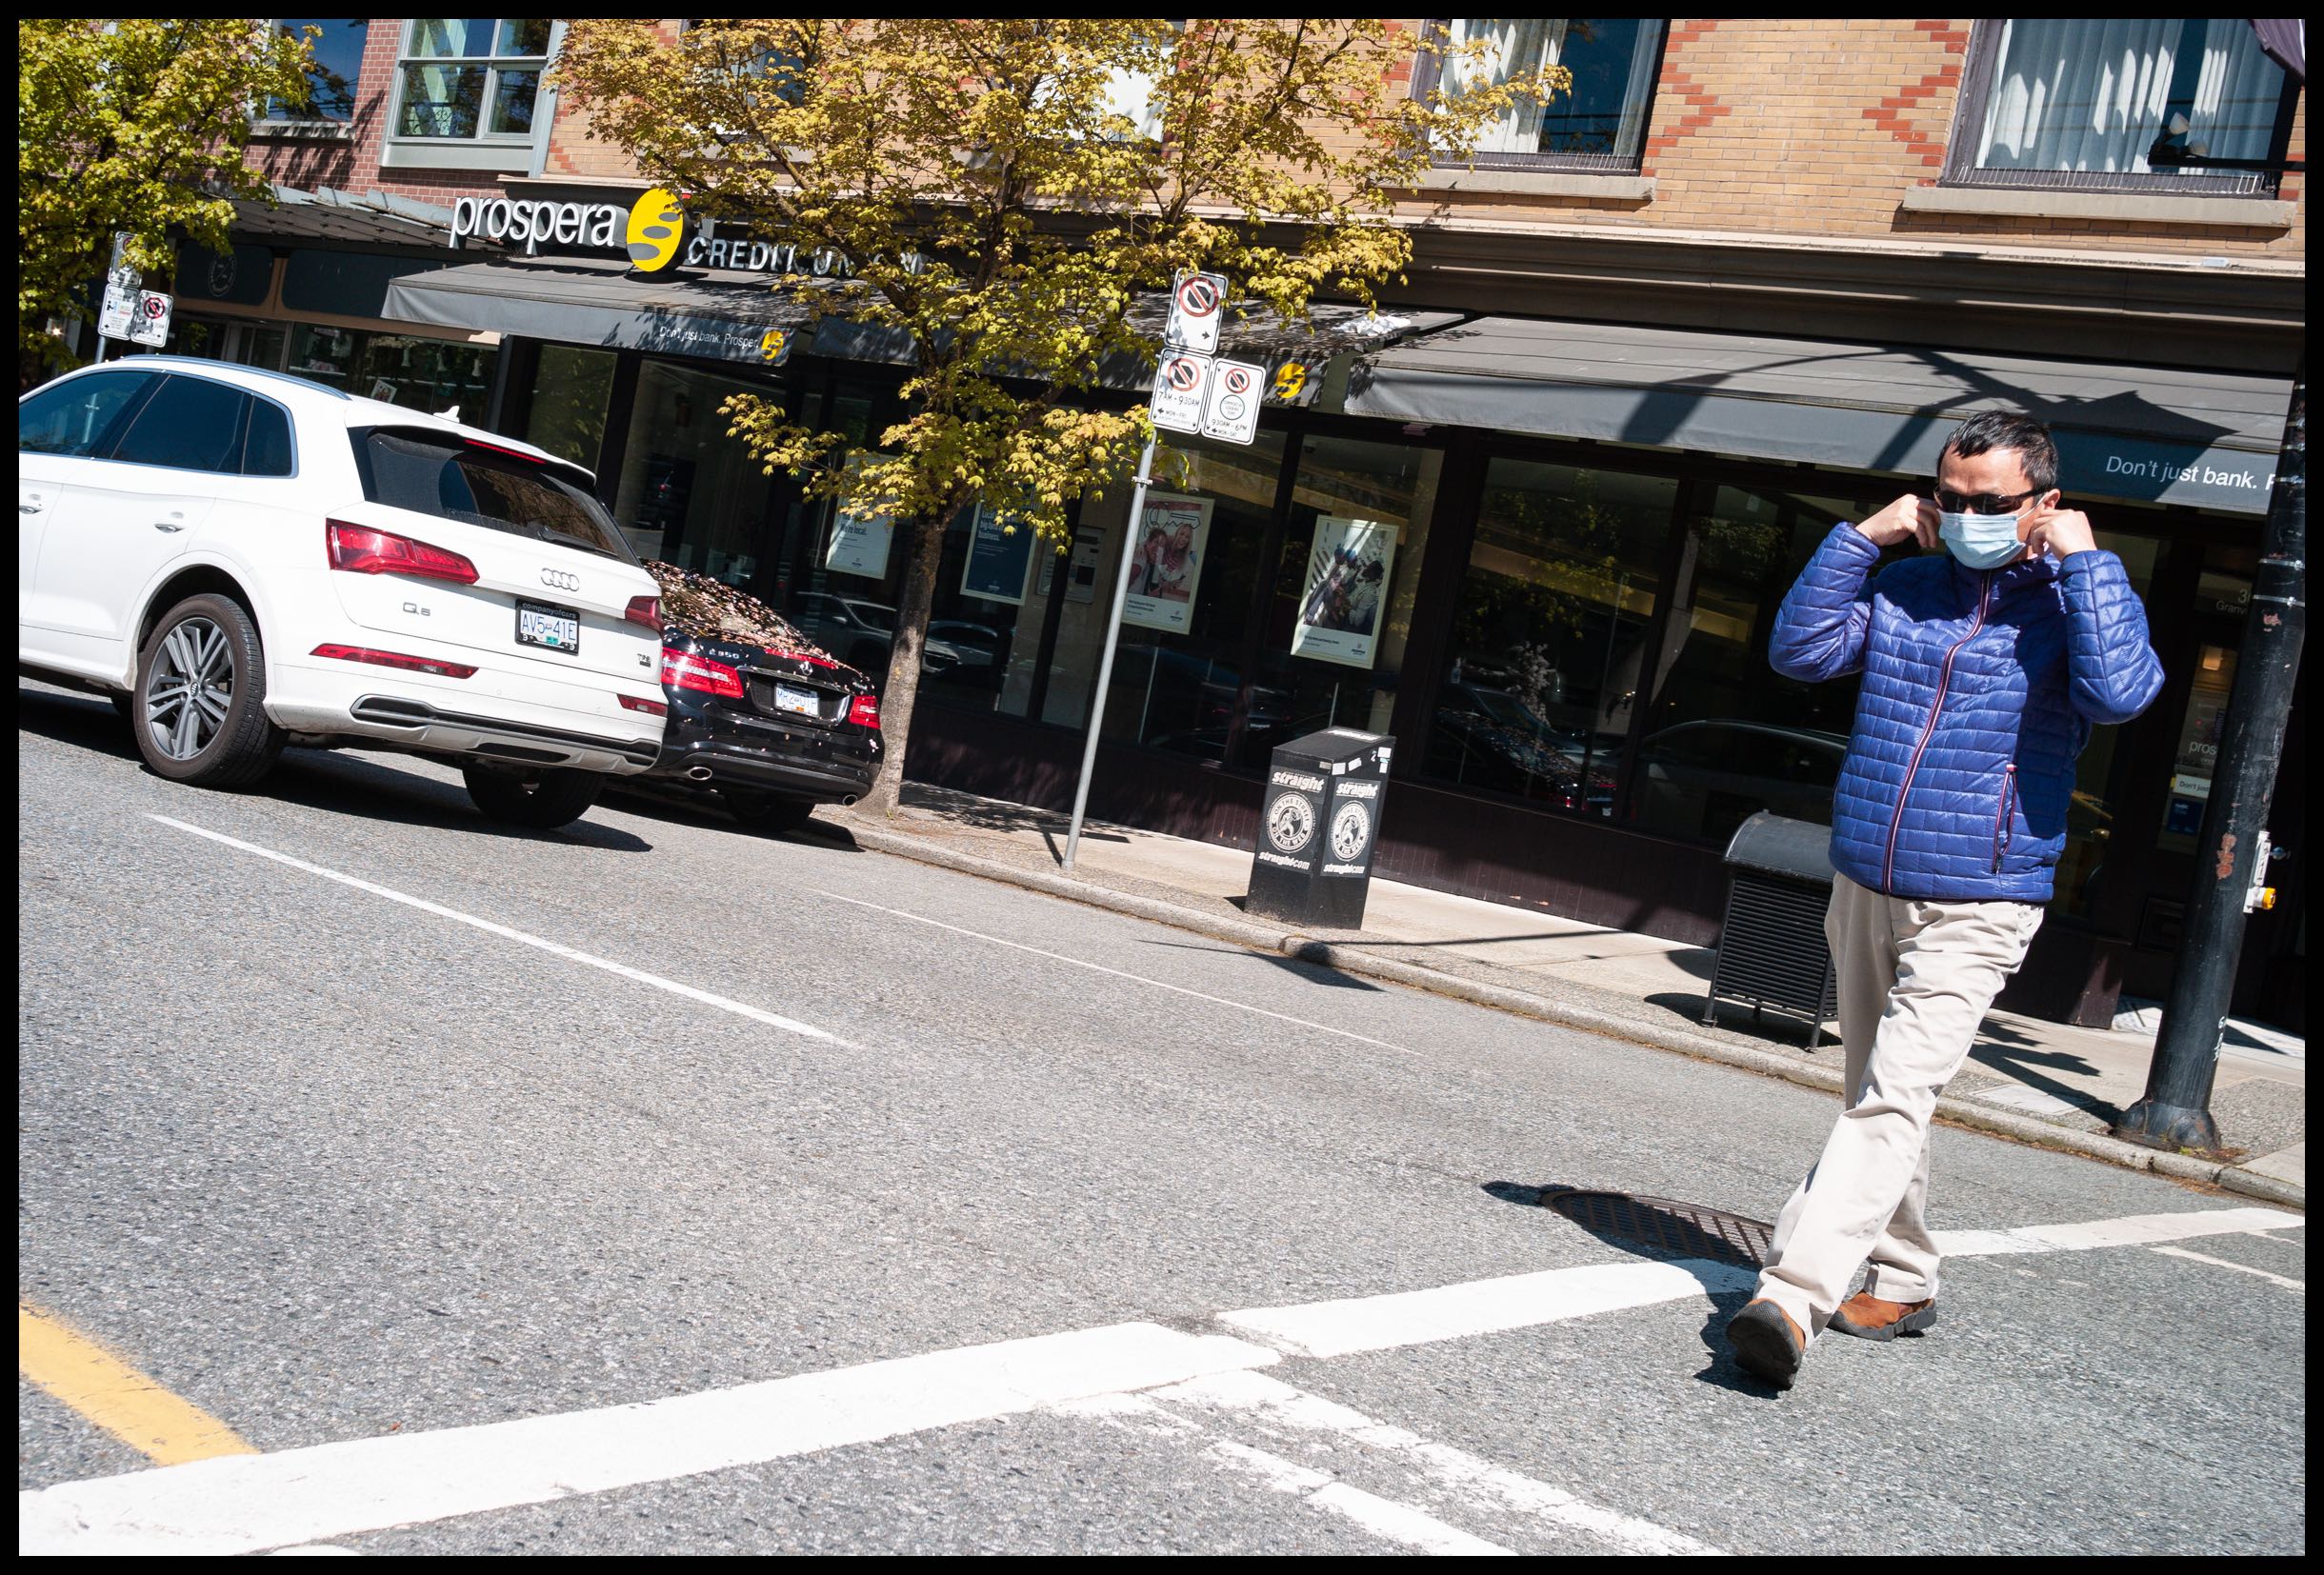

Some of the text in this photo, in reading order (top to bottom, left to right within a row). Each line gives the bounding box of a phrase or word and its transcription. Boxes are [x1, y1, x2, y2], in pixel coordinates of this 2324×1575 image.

[449, 196, 615, 255] prospera
[688, 236, 799, 273] CREDIT
[659, 326, 759, 349] Don't just bank. Prosper.
[2106, 455, 2158, 478] Don't
[2159, 462, 2199, 483] just
[2202, 466, 2258, 489] bank.
[2188, 741, 2217, 756] pros
[1272, 771, 1325, 792] straight
[1336, 782, 1378, 798] straight
